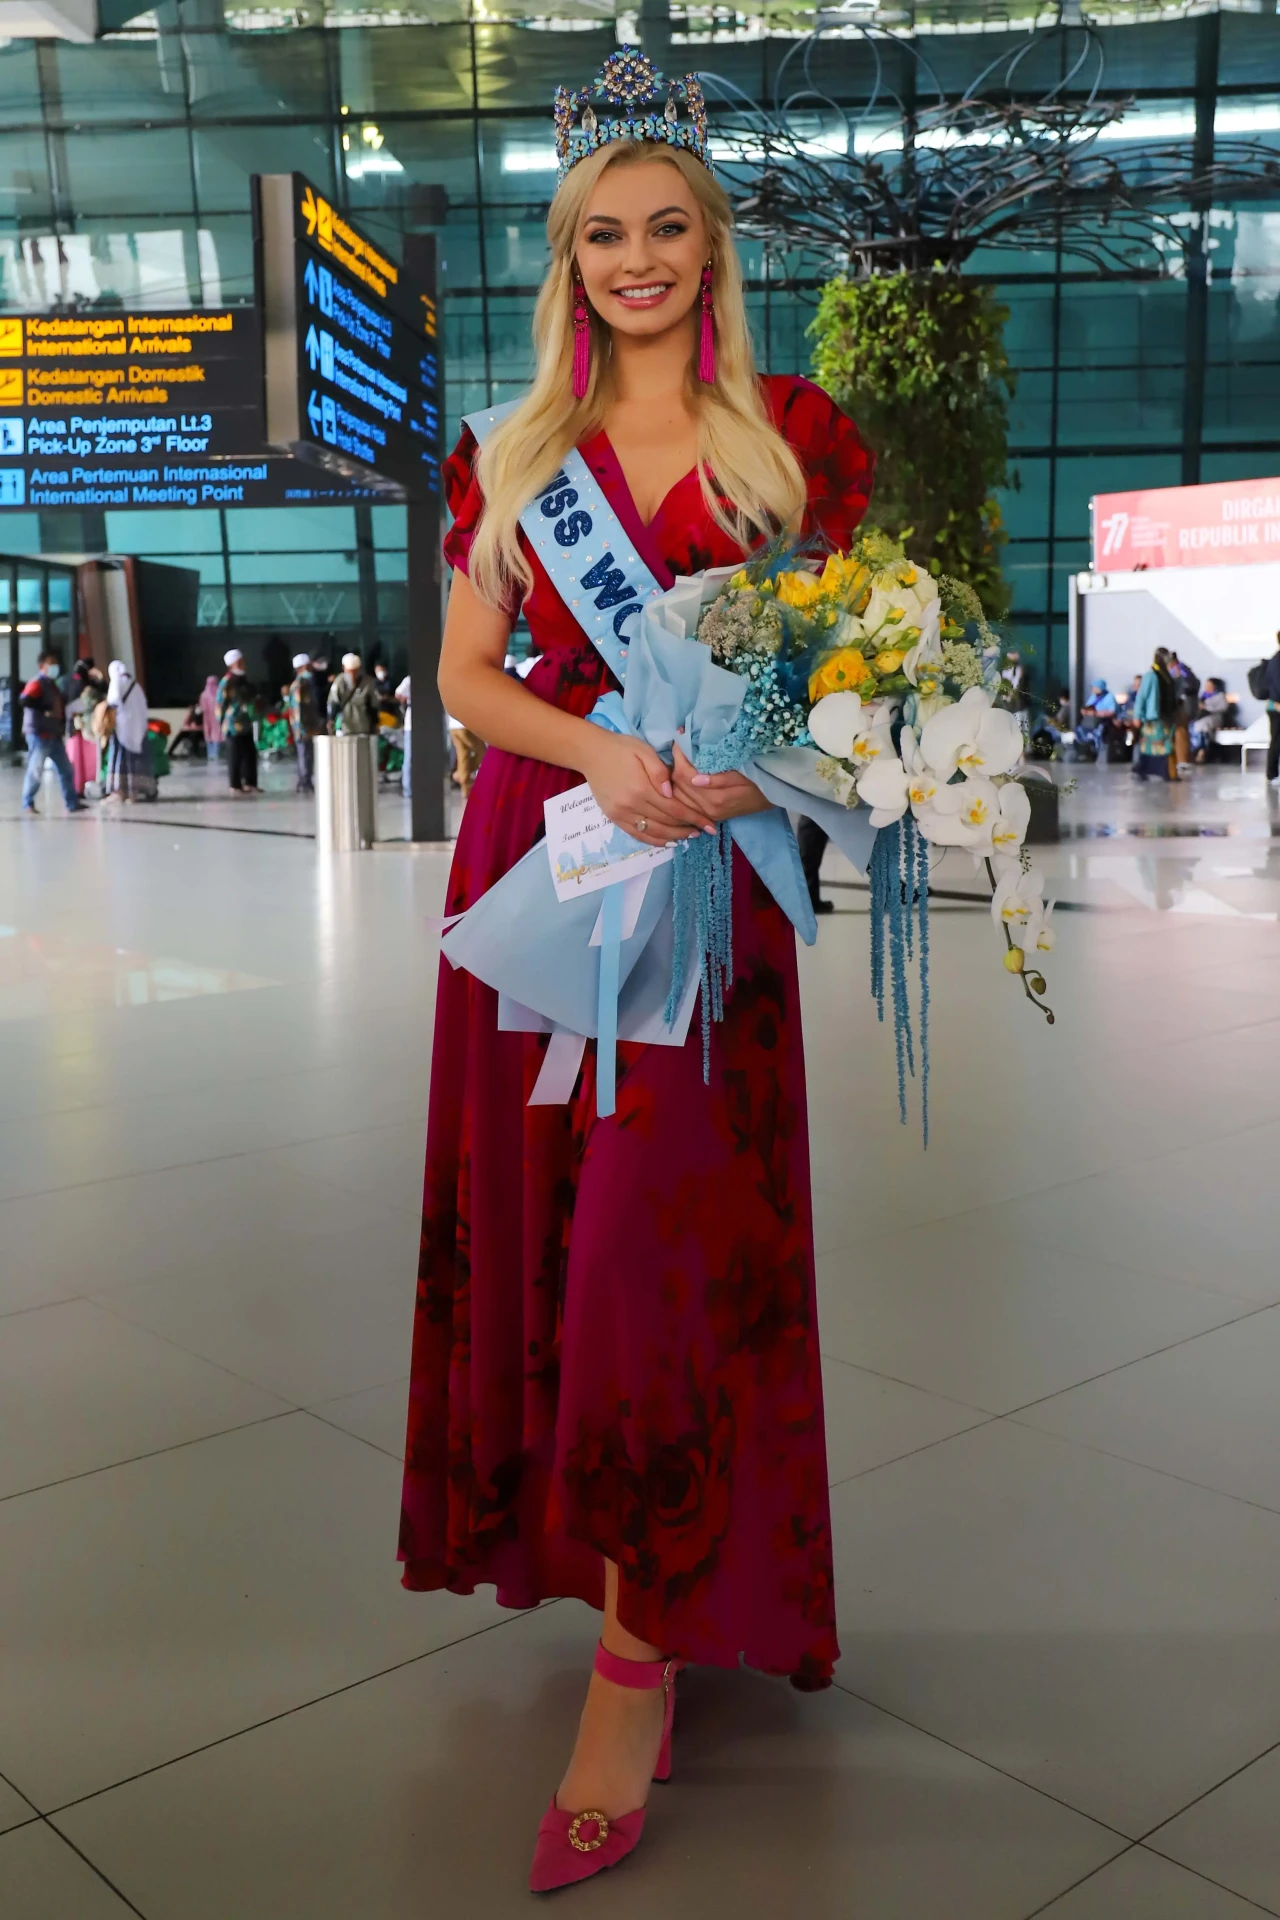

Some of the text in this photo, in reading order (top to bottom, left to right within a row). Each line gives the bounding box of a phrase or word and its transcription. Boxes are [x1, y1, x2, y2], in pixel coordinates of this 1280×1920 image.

[26, 313, 233, 338] Kedatangan Internasional
[26, 335, 192, 356] International Arrivals
[27, 364, 206, 388] Kedatangan Domestik
[27, 386, 169, 406] Domestic Arrivals
[27, 414, 213, 436] Area Penjemputan Lt.3
[28, 437, 92, 458] Pick-Up
[95, 436, 138, 454] Zone
[166, 435, 209, 452] Floor
[30, 463, 268, 485] Area Pertemuan Internasional
[30, 484, 244, 506] International Meeting Point
[534, 469, 592, 546] ISS
[1101, 511, 1129, 557] 77
[1178, 524, 1259, 548] REPUBLIK
[560, 795, 594, 814] Welcome
[562, 830, 581, 843] Team
[583, 823, 601, 835] Miss
